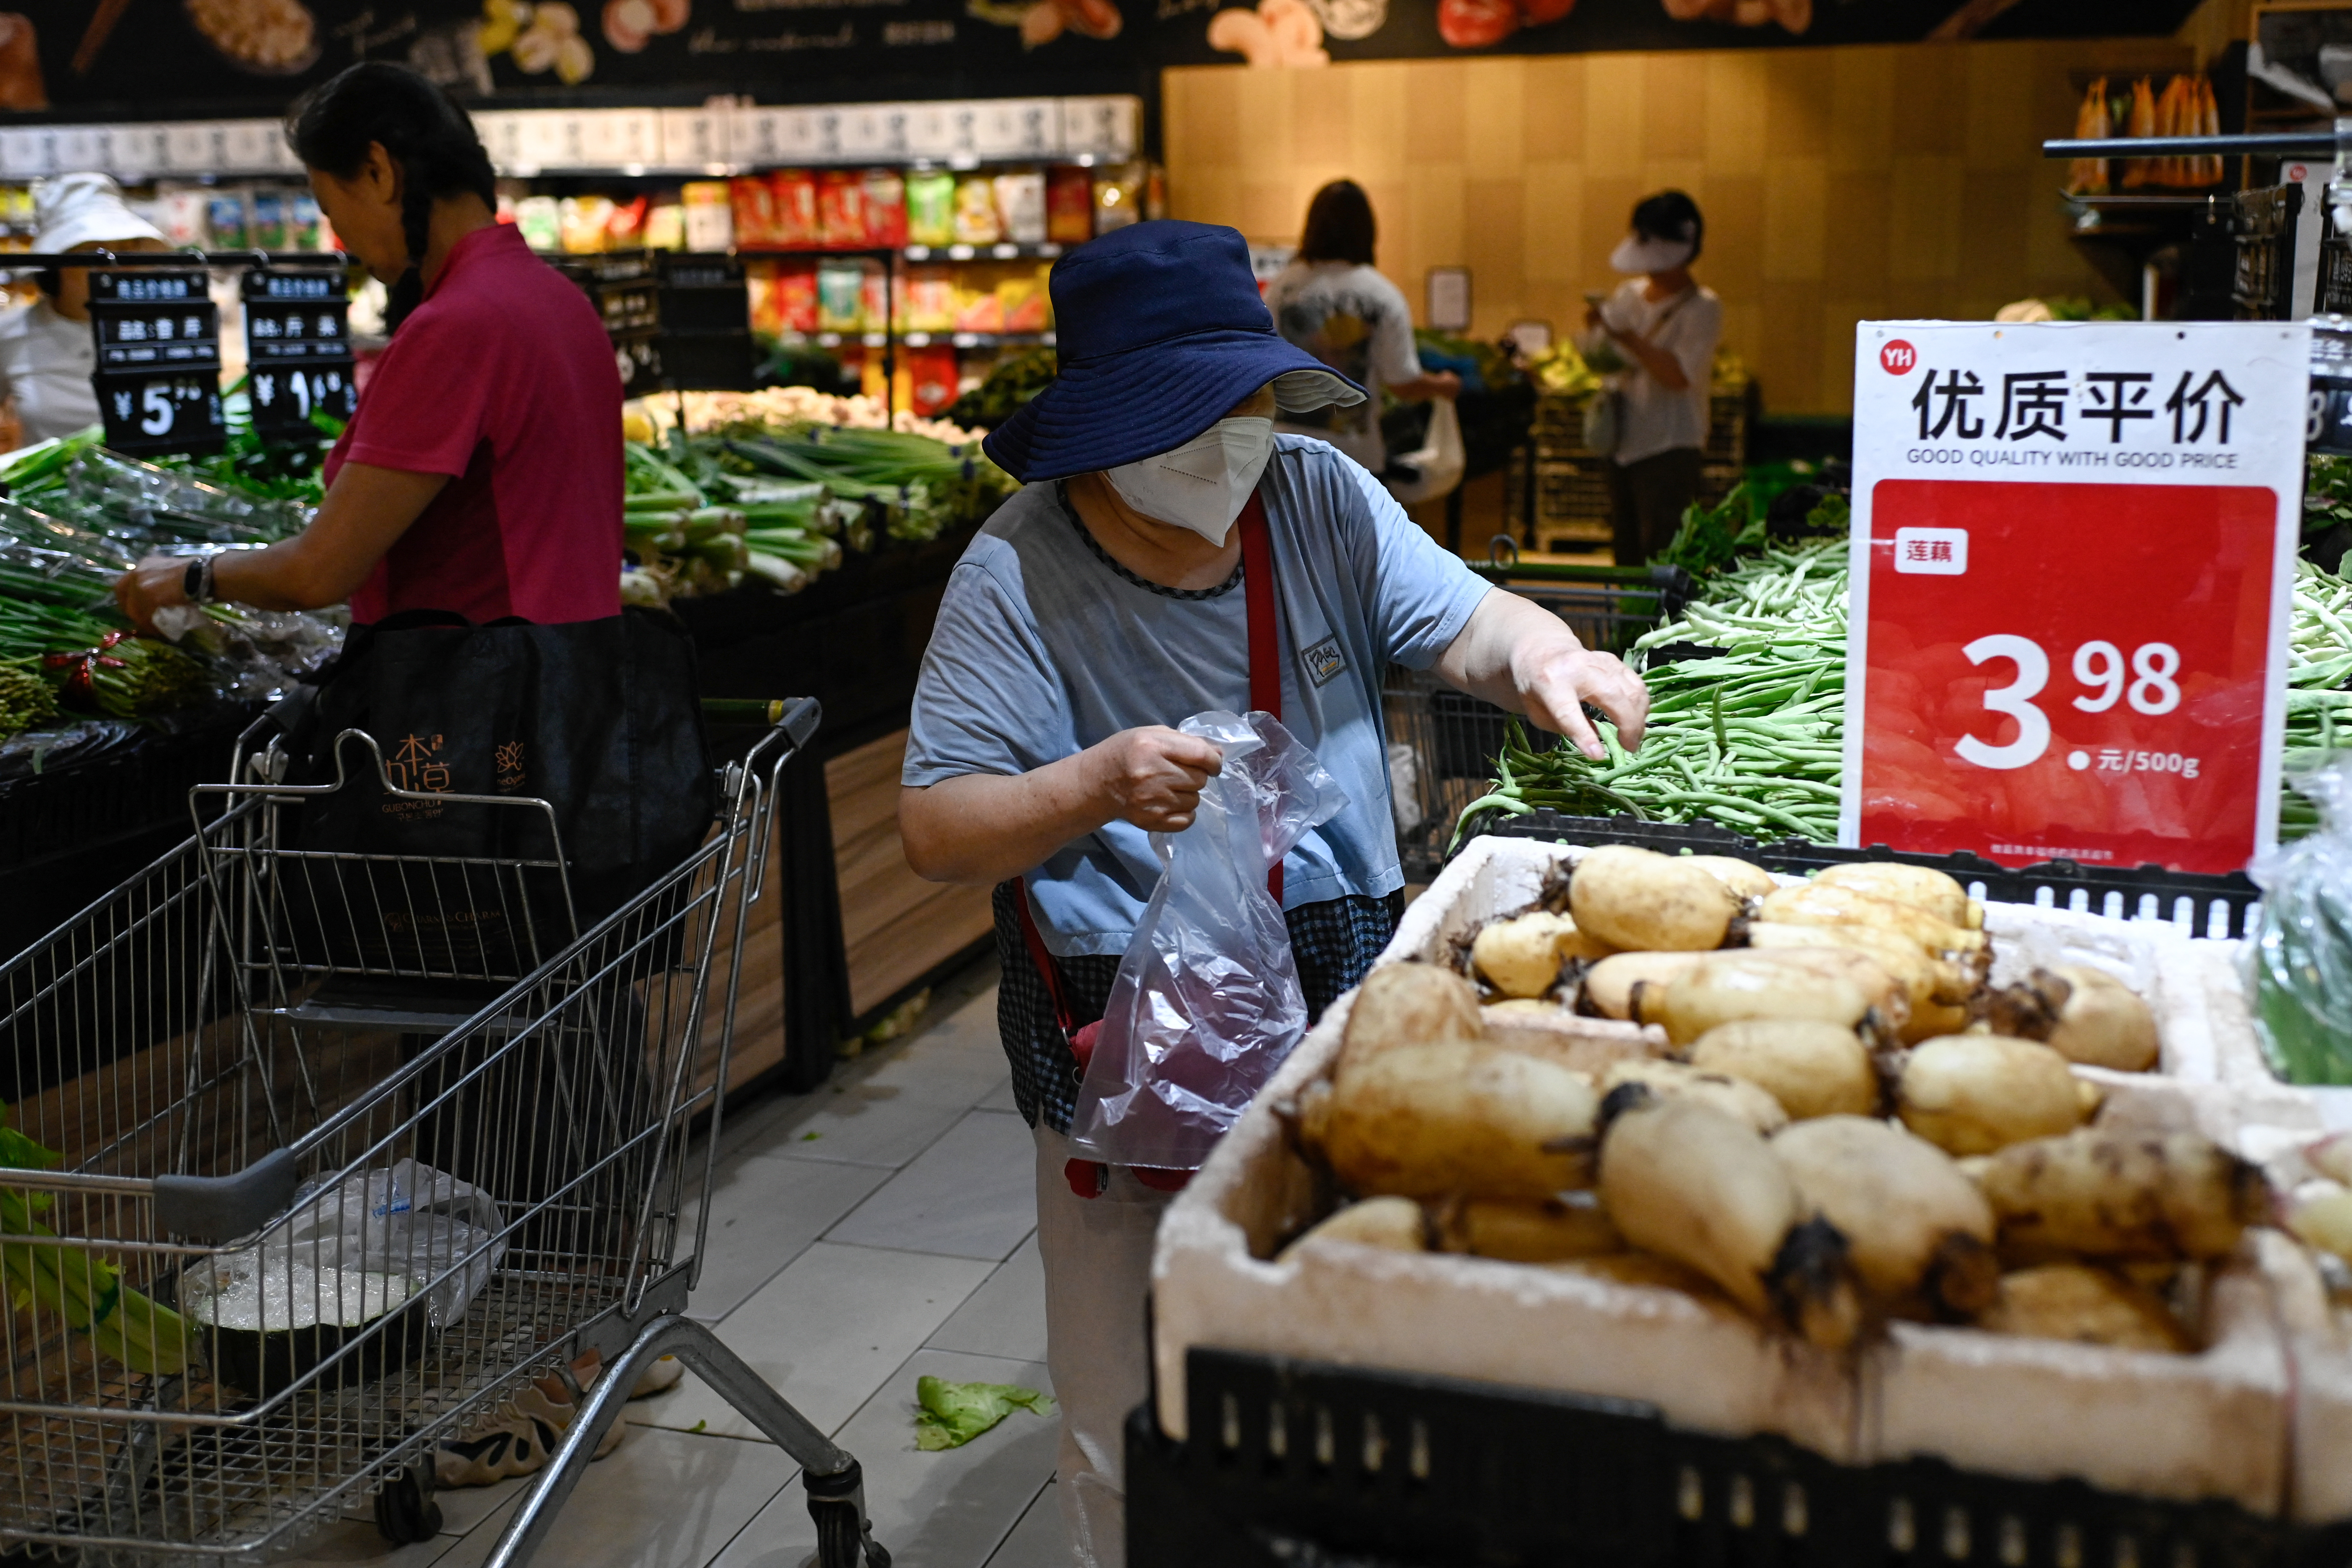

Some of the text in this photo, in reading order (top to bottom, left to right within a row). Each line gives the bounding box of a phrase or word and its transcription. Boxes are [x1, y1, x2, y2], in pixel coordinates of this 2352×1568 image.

[1884, 348, 1912, 367] YH
[1912, 368, 2244, 444] 优质平价
[1907, 449, 2238, 469] GOOD QUALITY WITH GOOD PRICE
[1906, 540, 1952, 562] 莲藕
[2098, 750, 2199, 778] 元/500g
[382, 800, 435, 814] GUBONCHO
